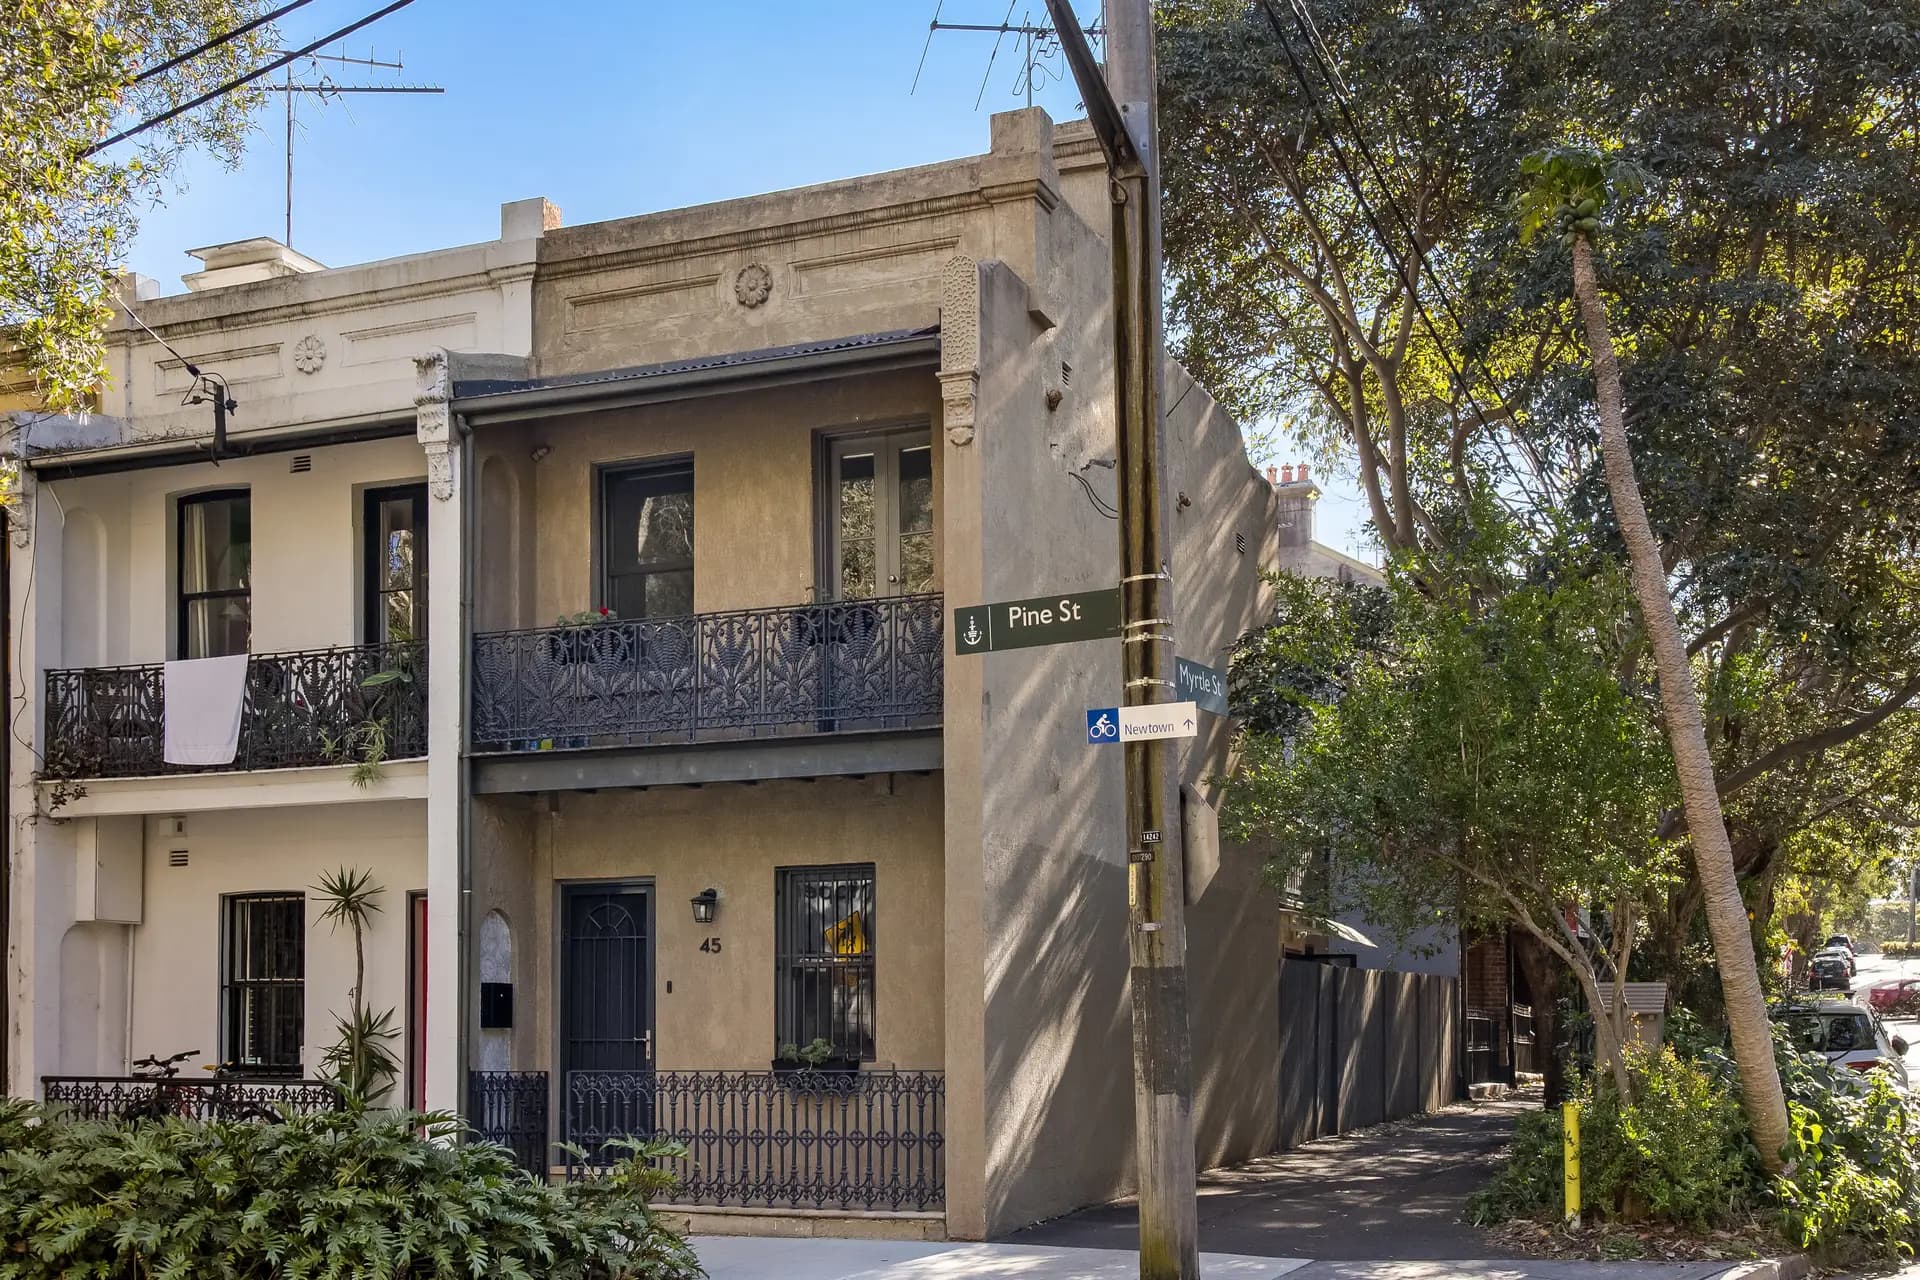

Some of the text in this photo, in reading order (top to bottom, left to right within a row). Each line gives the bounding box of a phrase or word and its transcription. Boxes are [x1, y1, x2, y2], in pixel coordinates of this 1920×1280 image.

[1009, 600, 1081, 629] Pine St
[1179, 663, 1222, 697] Myrtle St
[1124, 723, 1175, 736] Newtown
[699, 937, 722, 954] 45
